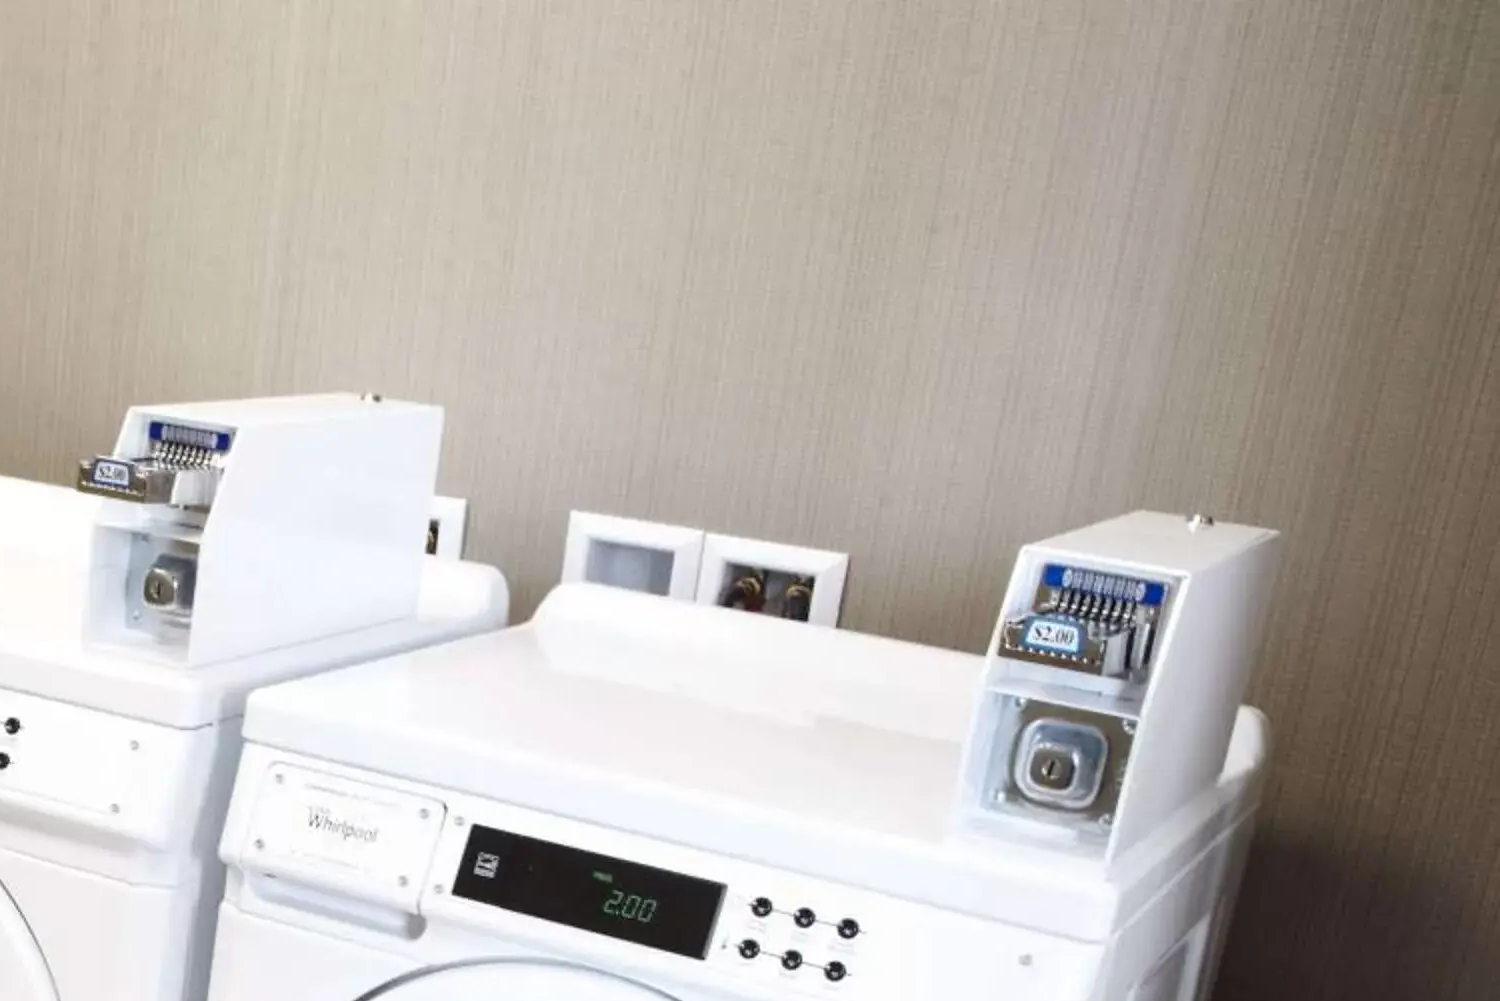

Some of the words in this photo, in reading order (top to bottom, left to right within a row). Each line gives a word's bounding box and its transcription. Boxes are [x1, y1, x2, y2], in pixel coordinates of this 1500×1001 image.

[1031, 624, 1076, 646] $2.00
[307, 809, 380, 844] Whirlpool
[603, 889, 657, 923] 2.00
